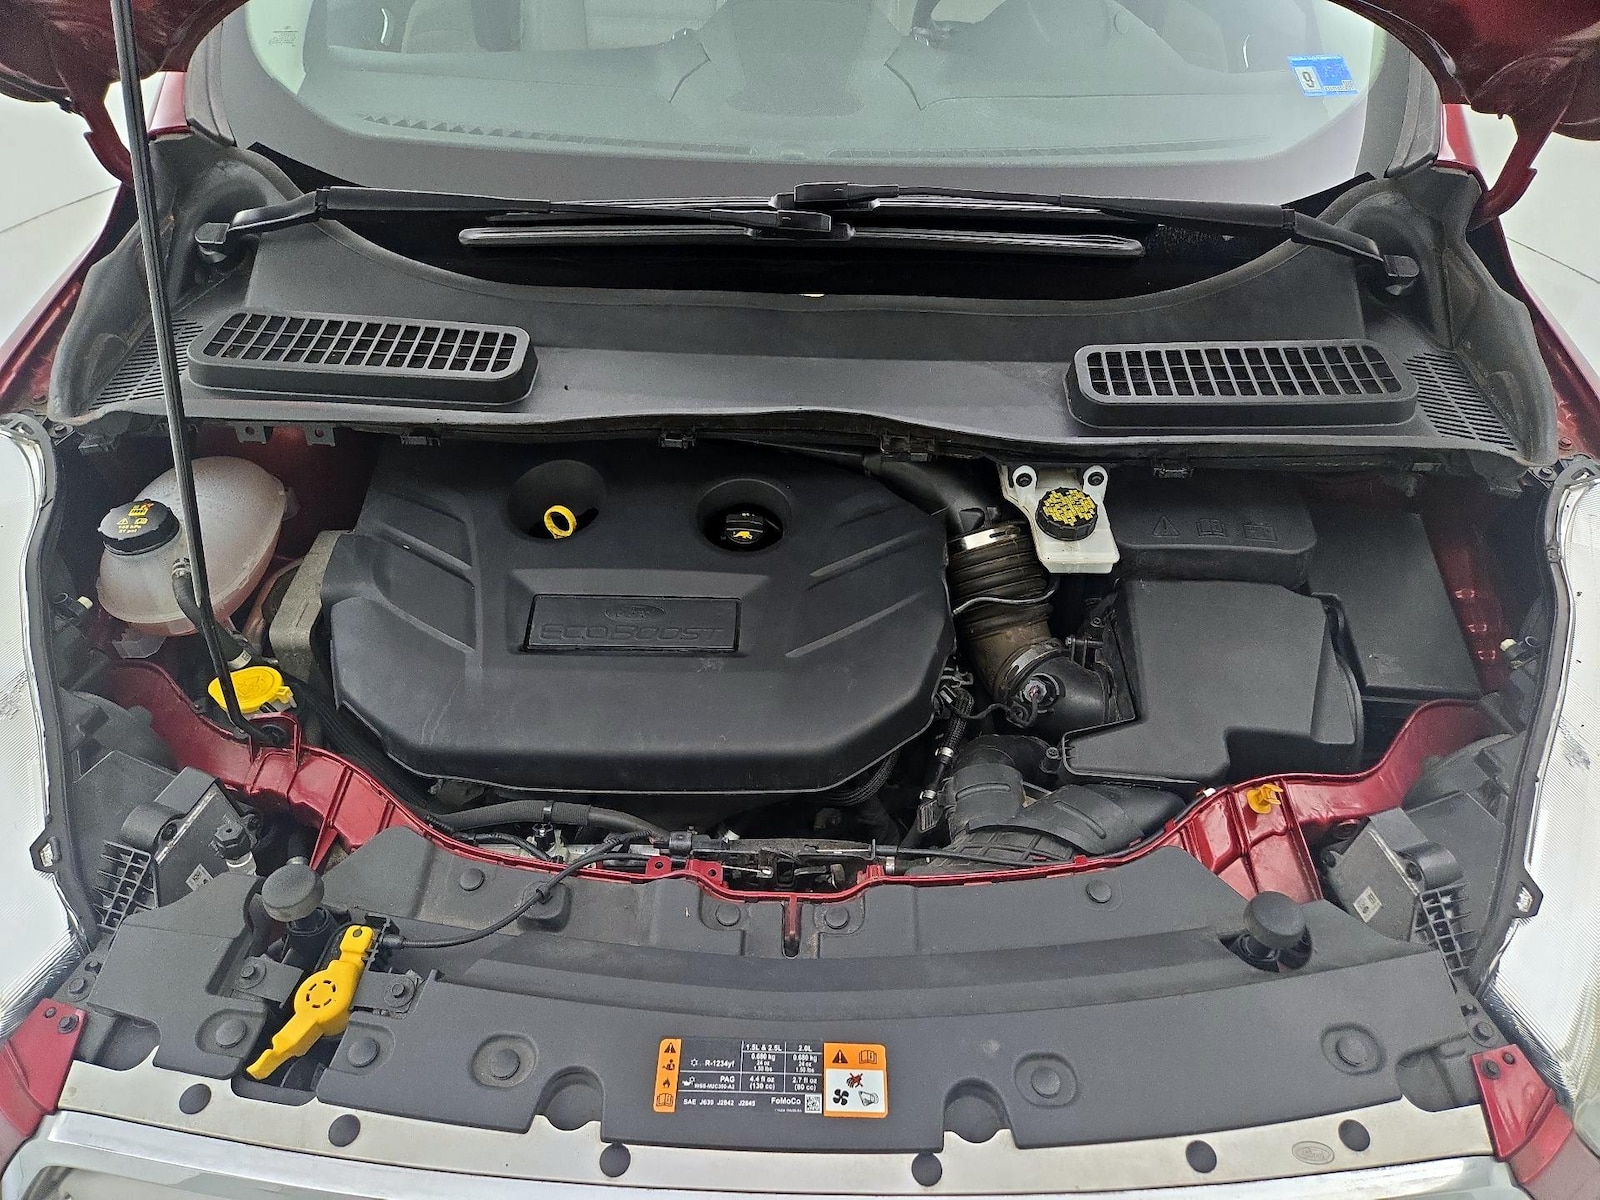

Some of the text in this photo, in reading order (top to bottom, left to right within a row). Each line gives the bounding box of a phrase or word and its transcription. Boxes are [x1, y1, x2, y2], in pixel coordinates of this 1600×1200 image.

[768, 1053, 776, 1061] kg
[810, 1054, 818, 1063] kg
[704, 1059, 735, 1068] R-1234yf
[720, 1075, 735, 1083] PAG
[749, 1082, 764, 1090] (130
[770, 1097, 801, 1105] FoMoCo
